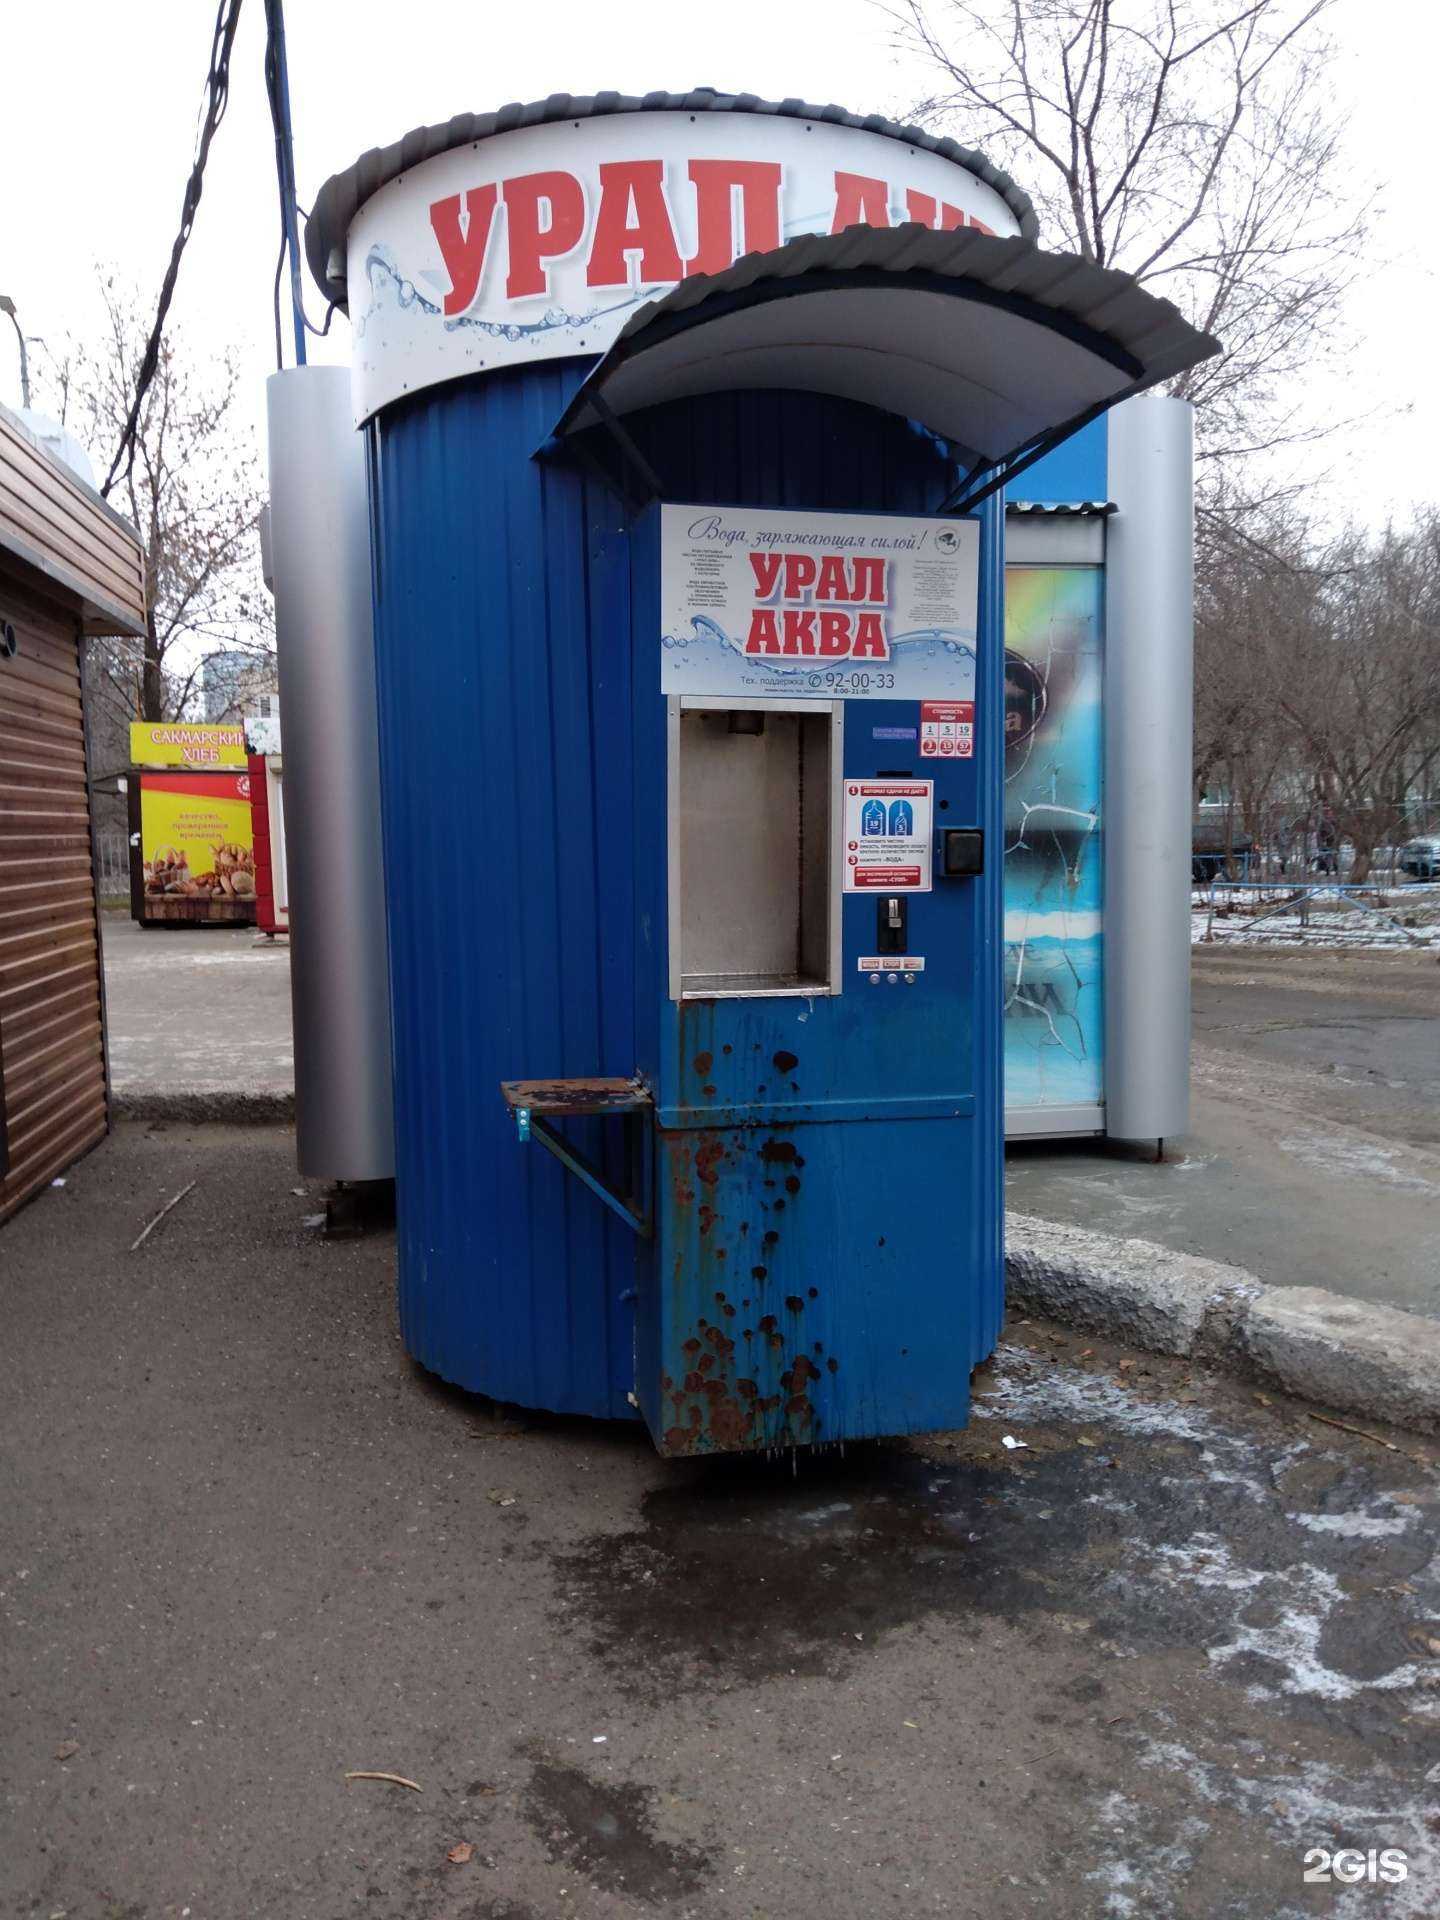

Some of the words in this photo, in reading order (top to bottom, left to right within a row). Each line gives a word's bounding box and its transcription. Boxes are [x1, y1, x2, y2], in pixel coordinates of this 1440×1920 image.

[430, 159, 783, 316] УРАЛ
[688, 515, 748, 547] Вода,
[751, 529, 865, 549] заряжающая
[871, 530, 928, 550] силой!
[749, 552, 886, 602] УРАЛ
[746, 609, 887, 657] АКВА
[741, 676, 756, 685] Тех.
[760, 678, 804, 686] поддержка
[825, 672, 895, 689] 92-00-33
[183, 748, 219, 762] ХЛЕБ
